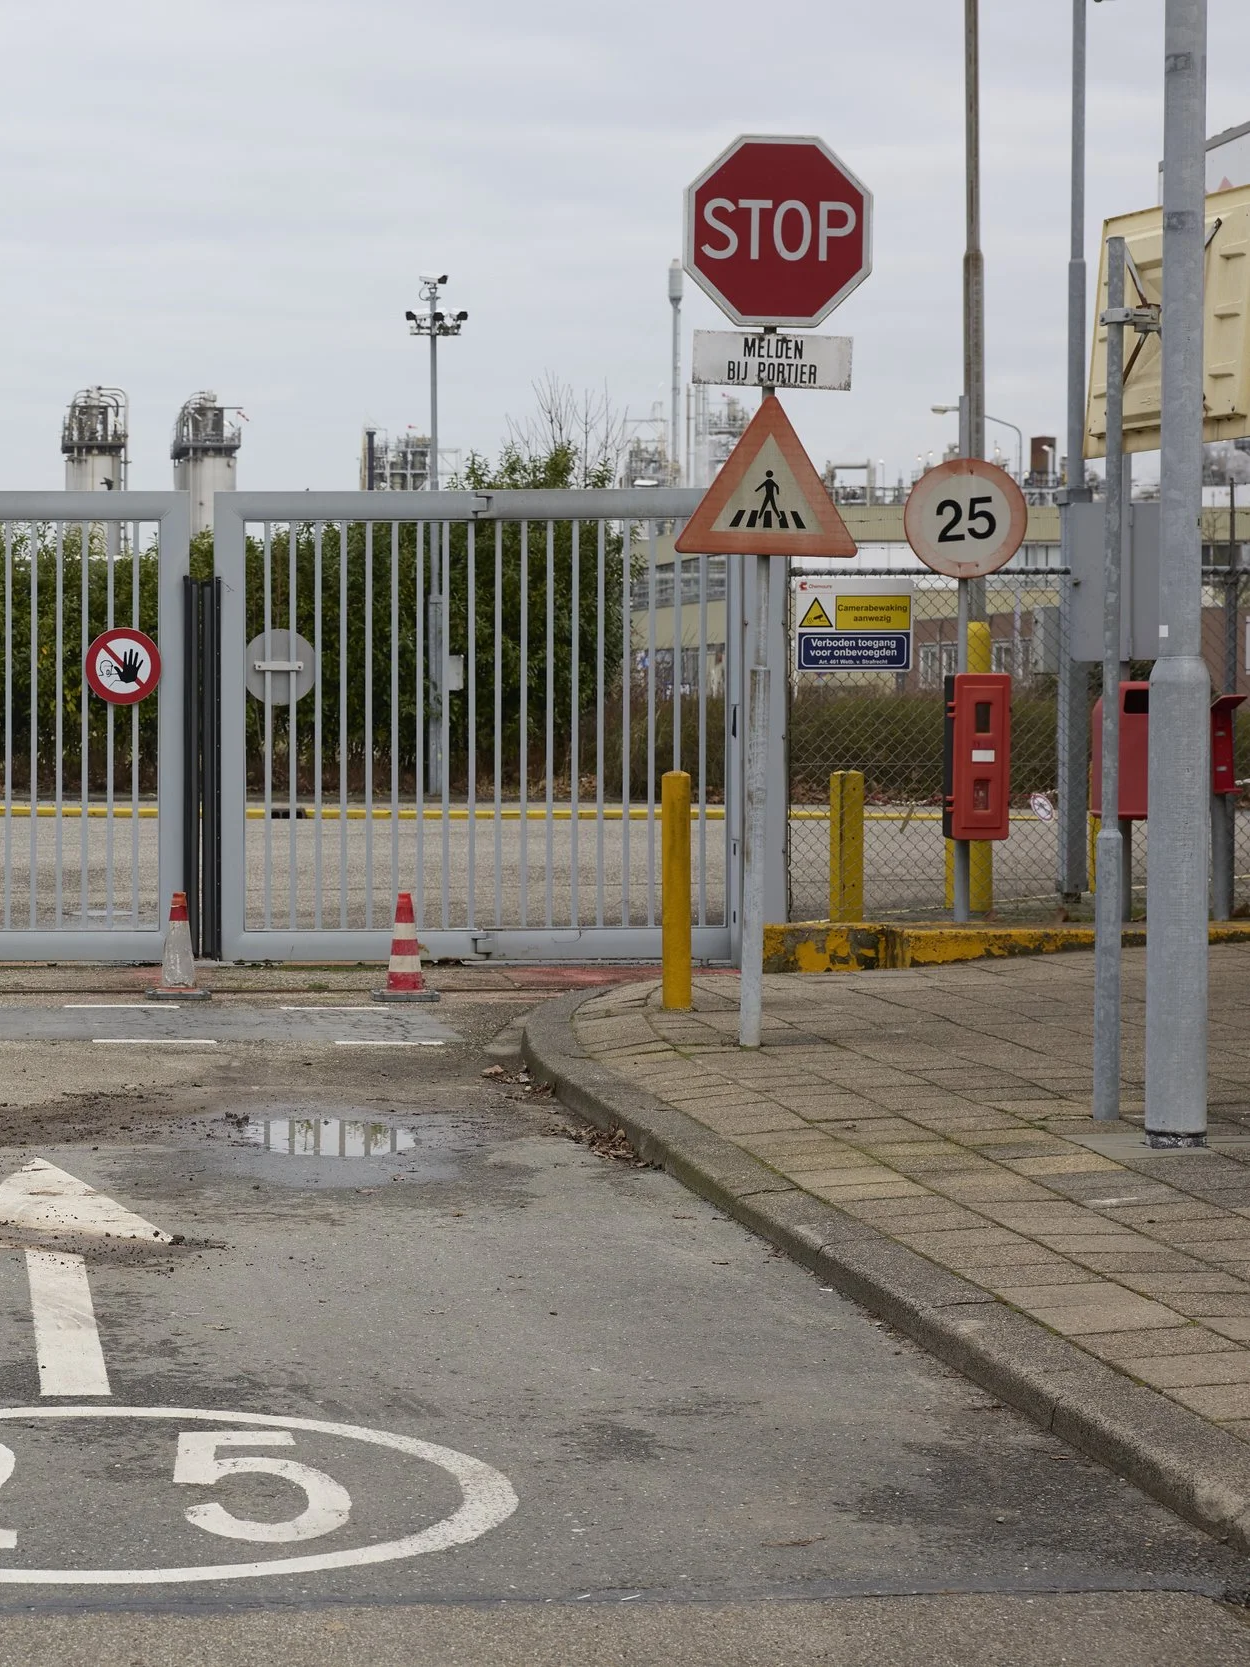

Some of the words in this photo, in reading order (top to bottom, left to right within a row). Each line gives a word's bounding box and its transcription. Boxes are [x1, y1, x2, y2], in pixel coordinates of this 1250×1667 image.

[701, 198, 857, 262] STOP
[743, 337, 804, 360] MELDEN
[727, 360, 748, 381] BIJ
[757, 361, 818, 385] PORTIER
[936, 496, 997, 543] 25
[837, 604, 908, 613] Camerabewaking
[853, 614, 892, 623] aanwezig
[810, 638, 856, 647] Verboden
[858, 639, 897, 649] toegang
[833, 648, 898, 658] onbevoegden
